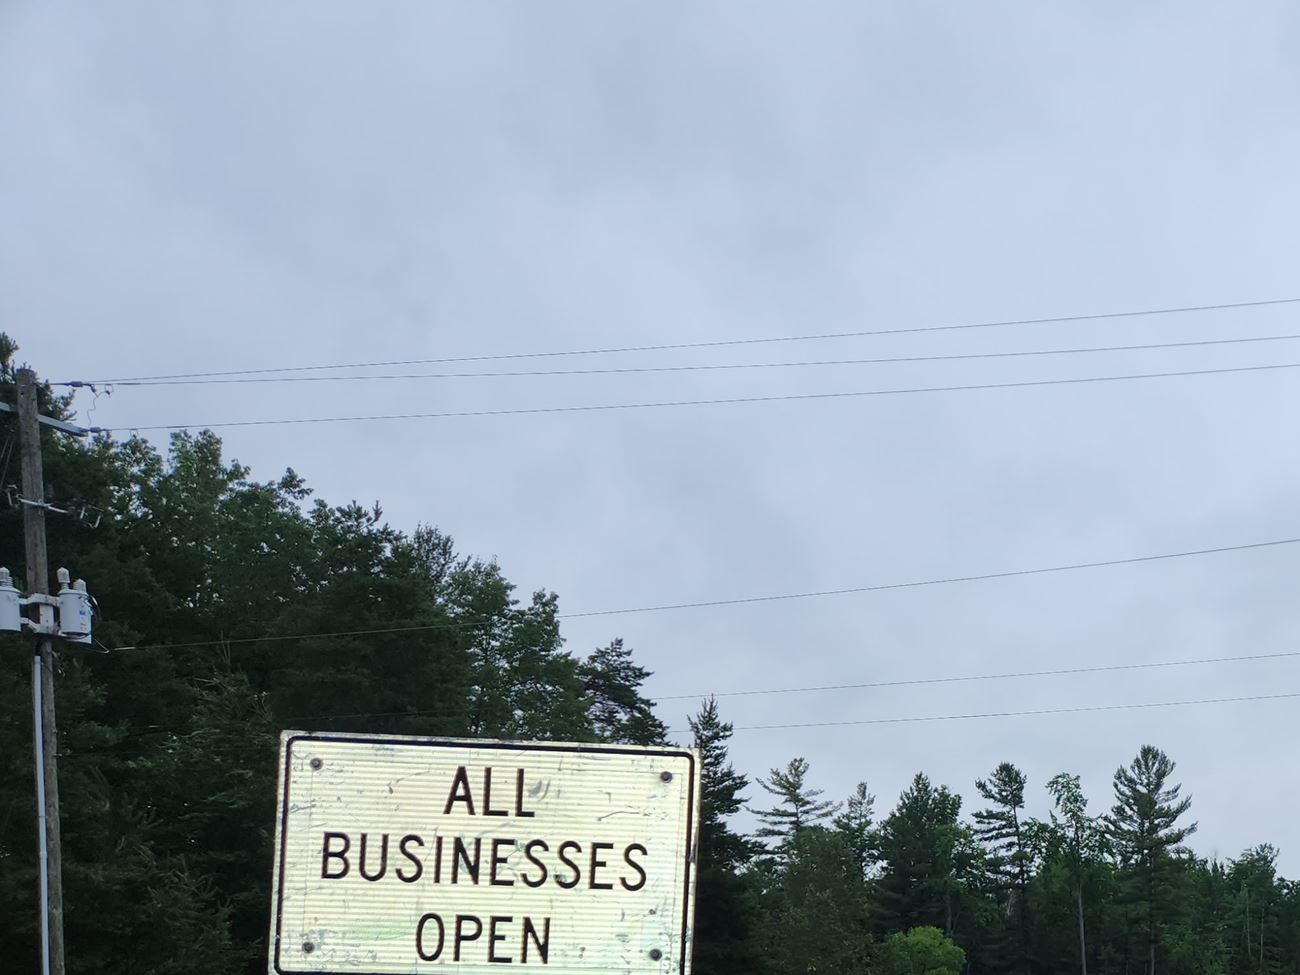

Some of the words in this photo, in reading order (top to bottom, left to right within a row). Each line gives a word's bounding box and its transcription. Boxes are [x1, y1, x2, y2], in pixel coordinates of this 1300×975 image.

[443, 766, 535, 818] ALL
[321, 832, 648, 891] BUSINESSES
[416, 912, 551, 964] OPEN
